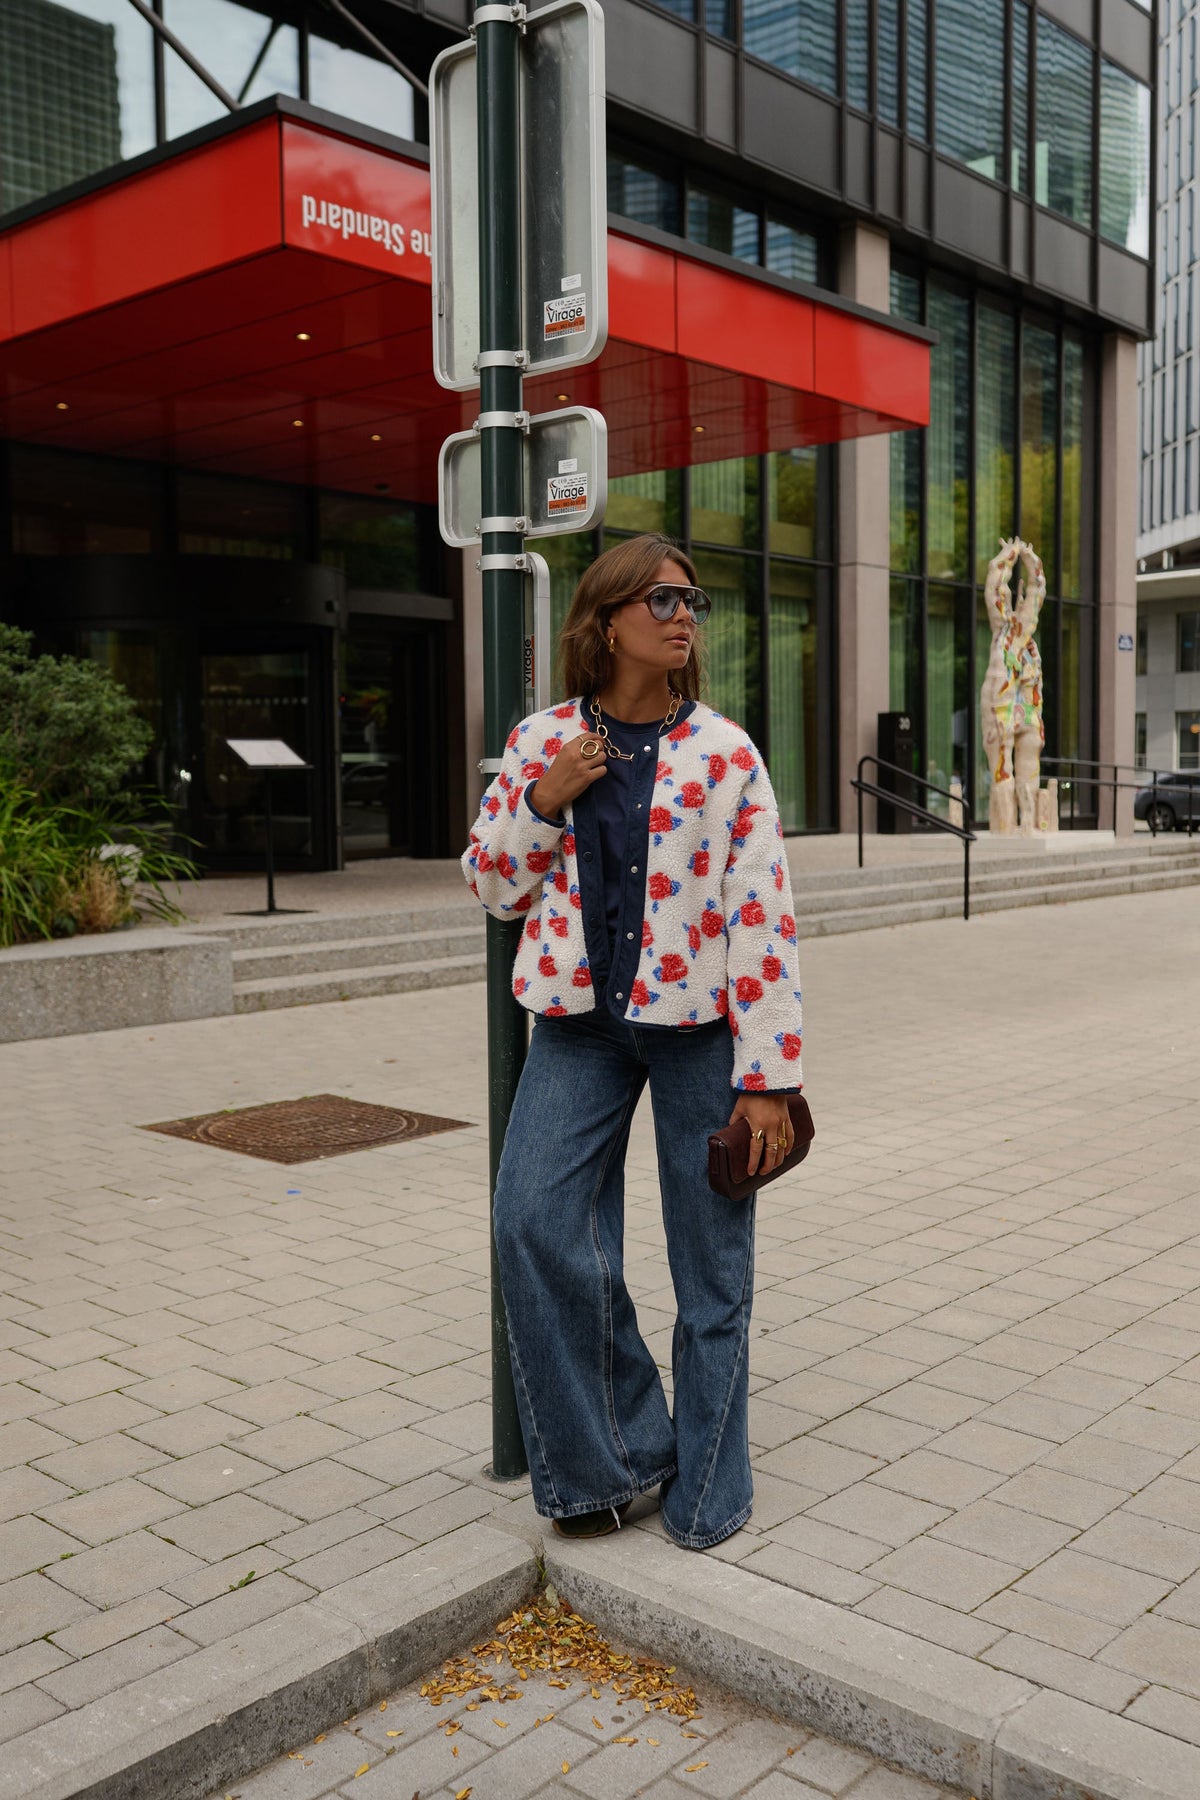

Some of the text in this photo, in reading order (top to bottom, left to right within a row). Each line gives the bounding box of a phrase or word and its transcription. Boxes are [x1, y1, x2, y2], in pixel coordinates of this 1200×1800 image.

[302, 195, 431, 258] he Standard
[547, 307, 583, 322] Virage
[551, 486, 584, 500] Virage
